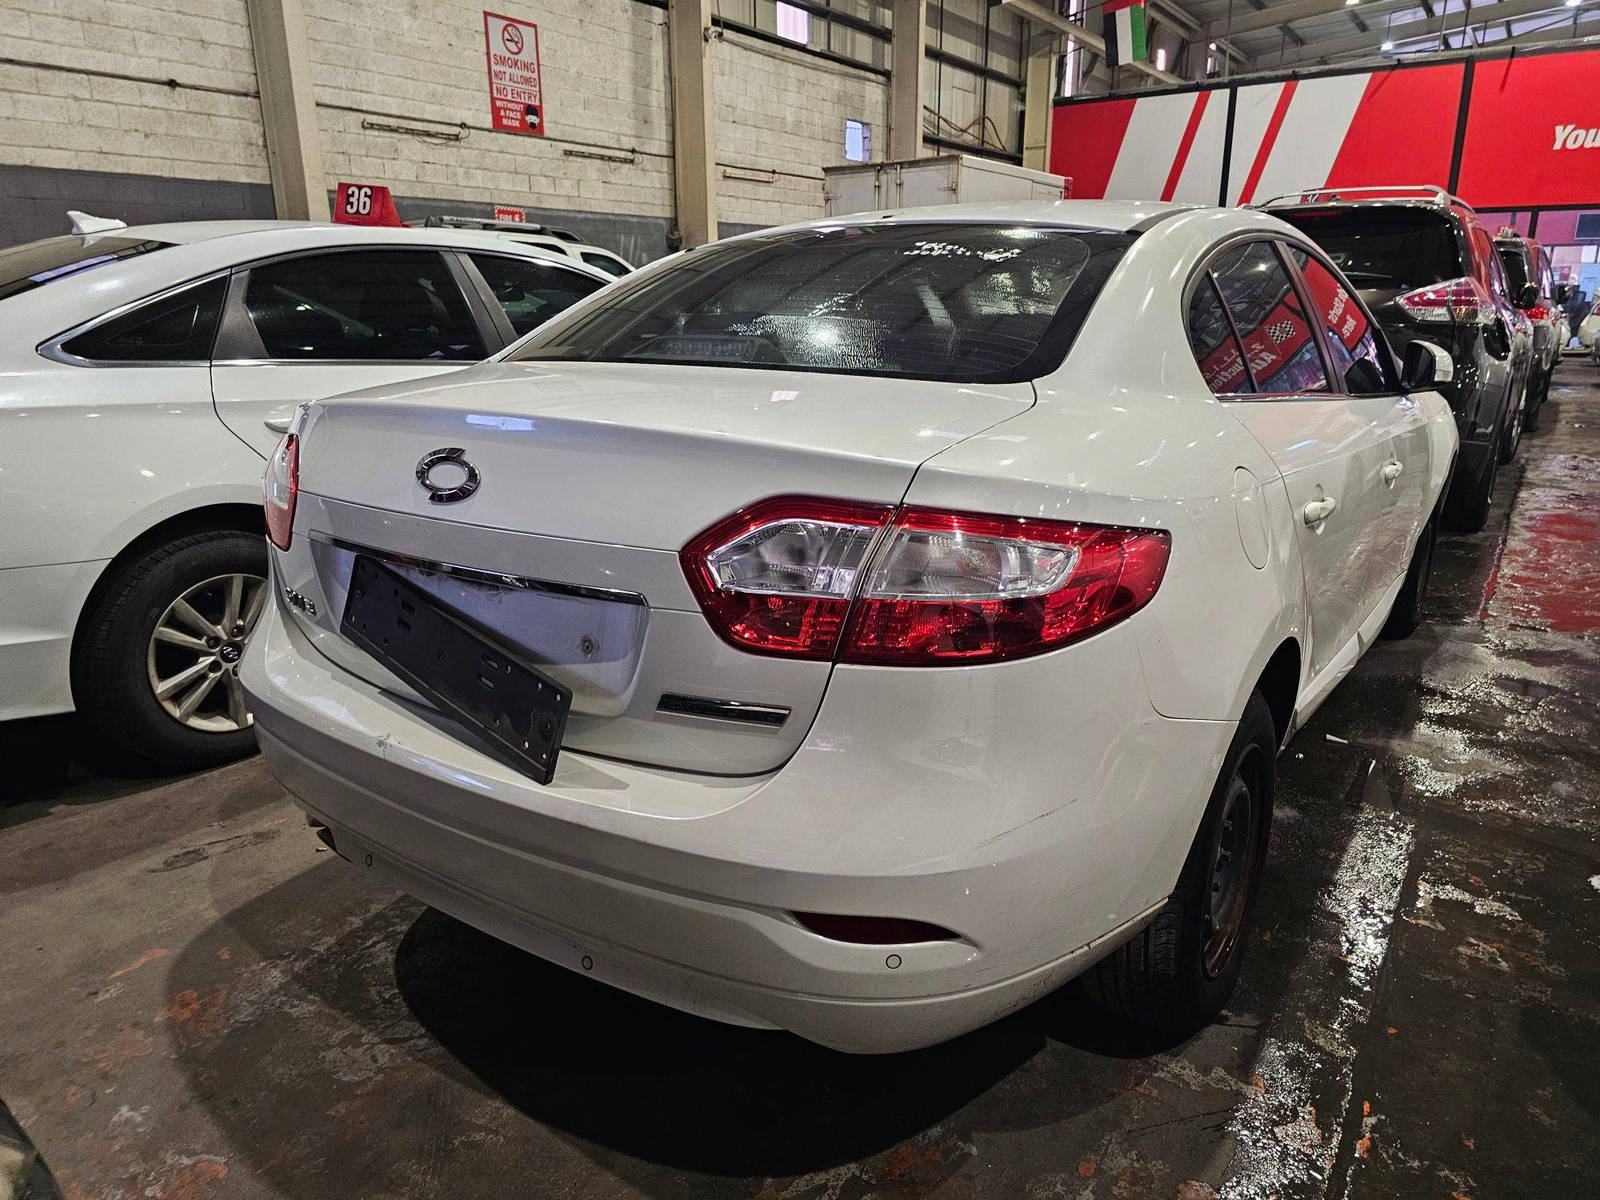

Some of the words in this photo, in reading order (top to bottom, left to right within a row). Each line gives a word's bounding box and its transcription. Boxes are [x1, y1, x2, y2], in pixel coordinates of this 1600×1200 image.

[493, 54, 536, 73] SMOKING
[493, 70, 507, 81] NOT
[509, 72, 537, 88] ALLOWED
[496, 86, 508, 98] NO
[511, 89, 538, 104] ENTRY
[495, 101, 524, 111] WITHOUT
[506, 111, 521, 119] FACE
[502, 118, 520, 127] MASK
[346, 186, 371, 215] 36
